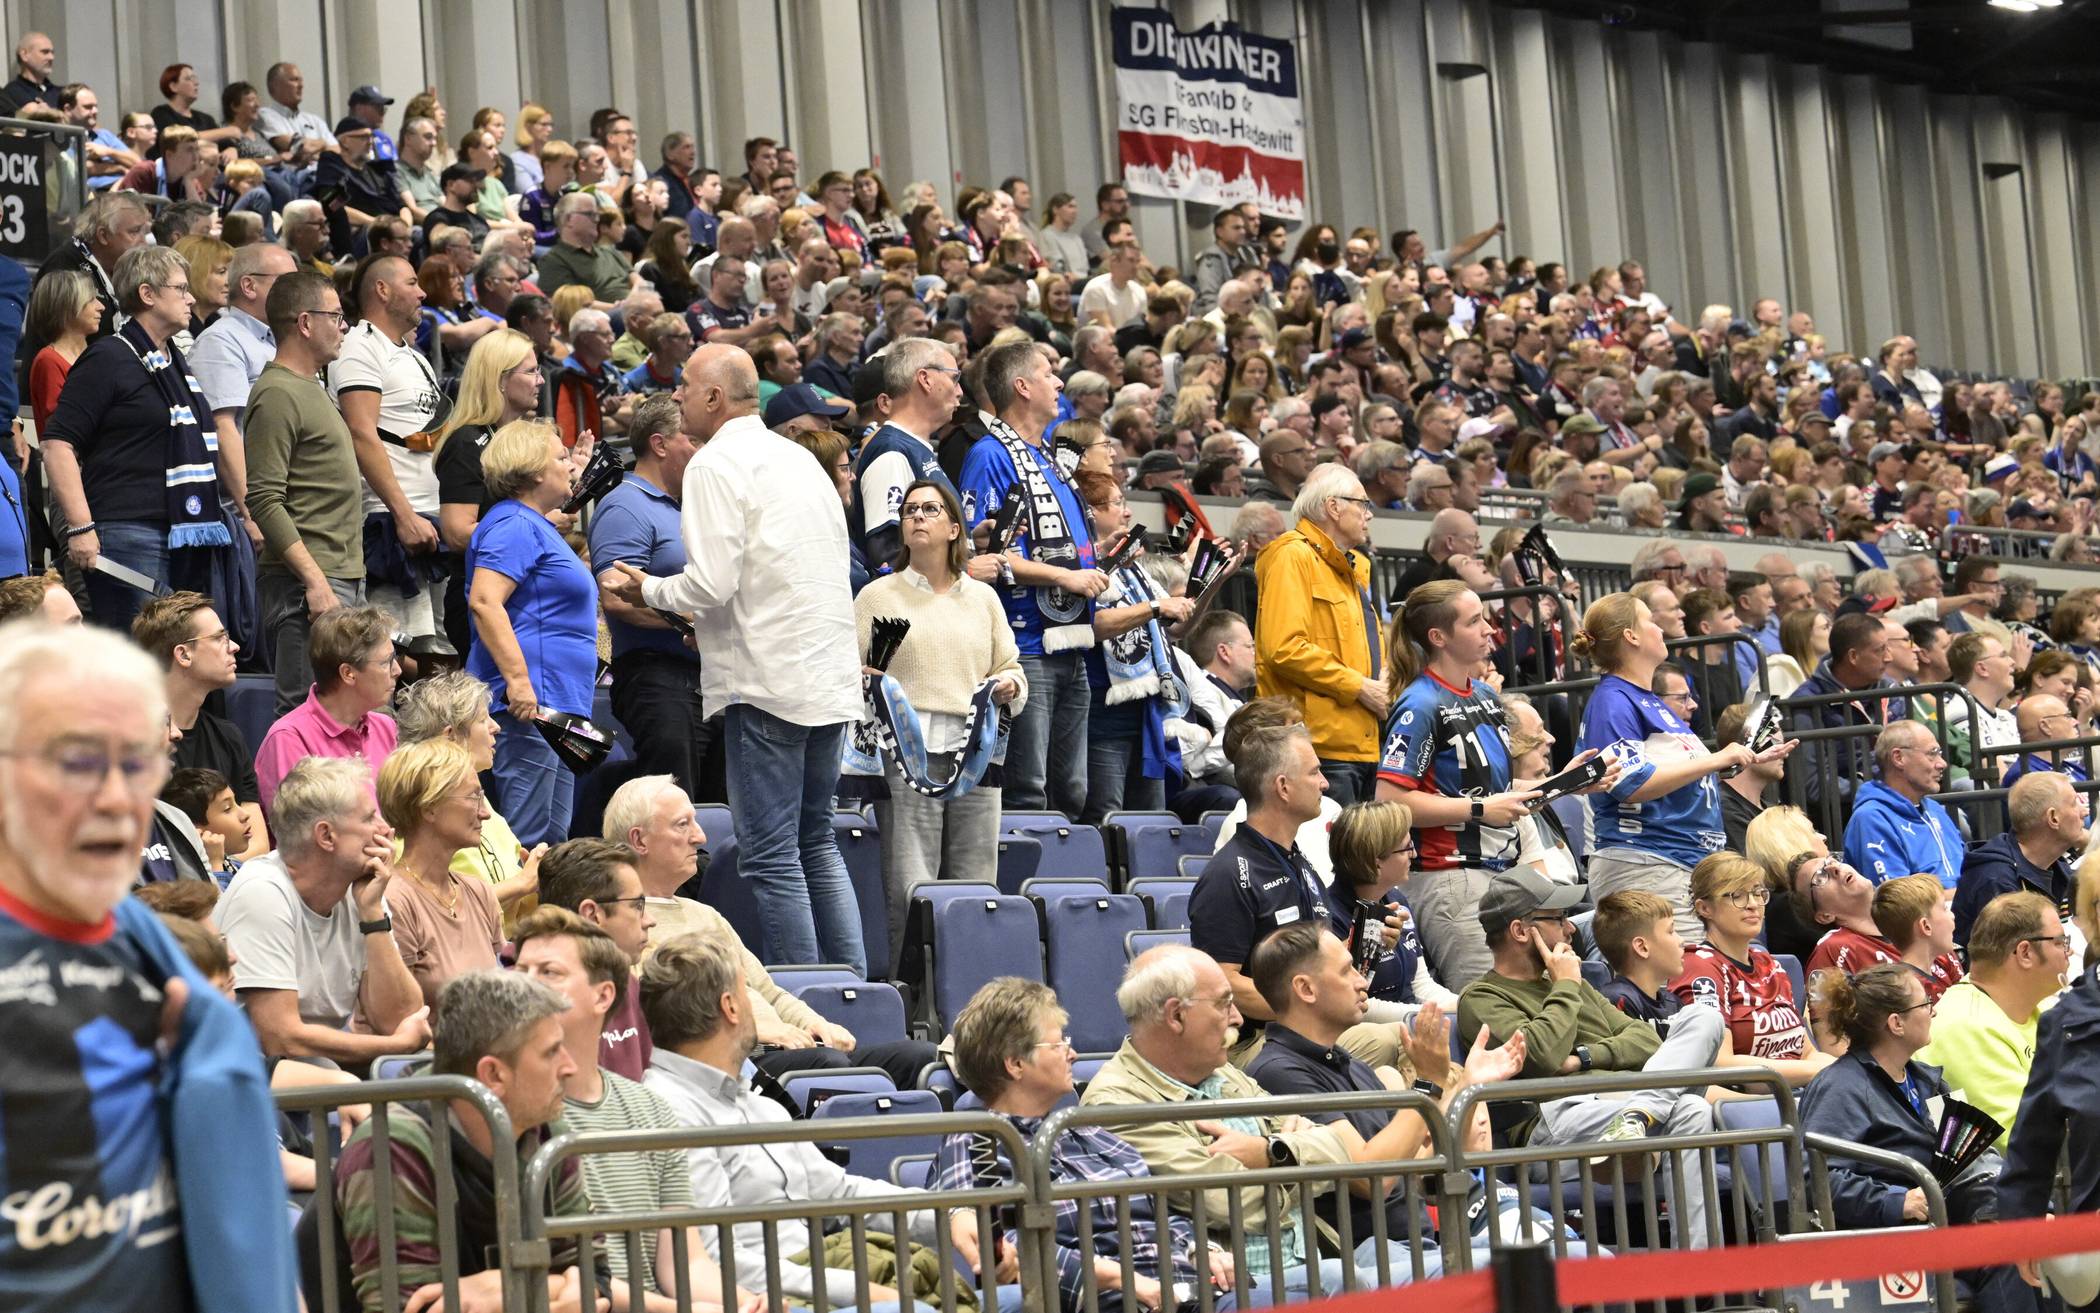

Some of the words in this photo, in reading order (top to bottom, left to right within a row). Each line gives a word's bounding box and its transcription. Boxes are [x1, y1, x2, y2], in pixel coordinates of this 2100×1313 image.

[1128, 103, 1156, 128] SG
[1447, 731, 1488, 770] 11
[1263, 877, 1285, 891] CRAFT
[1809, 1278, 1850, 1309] 4
